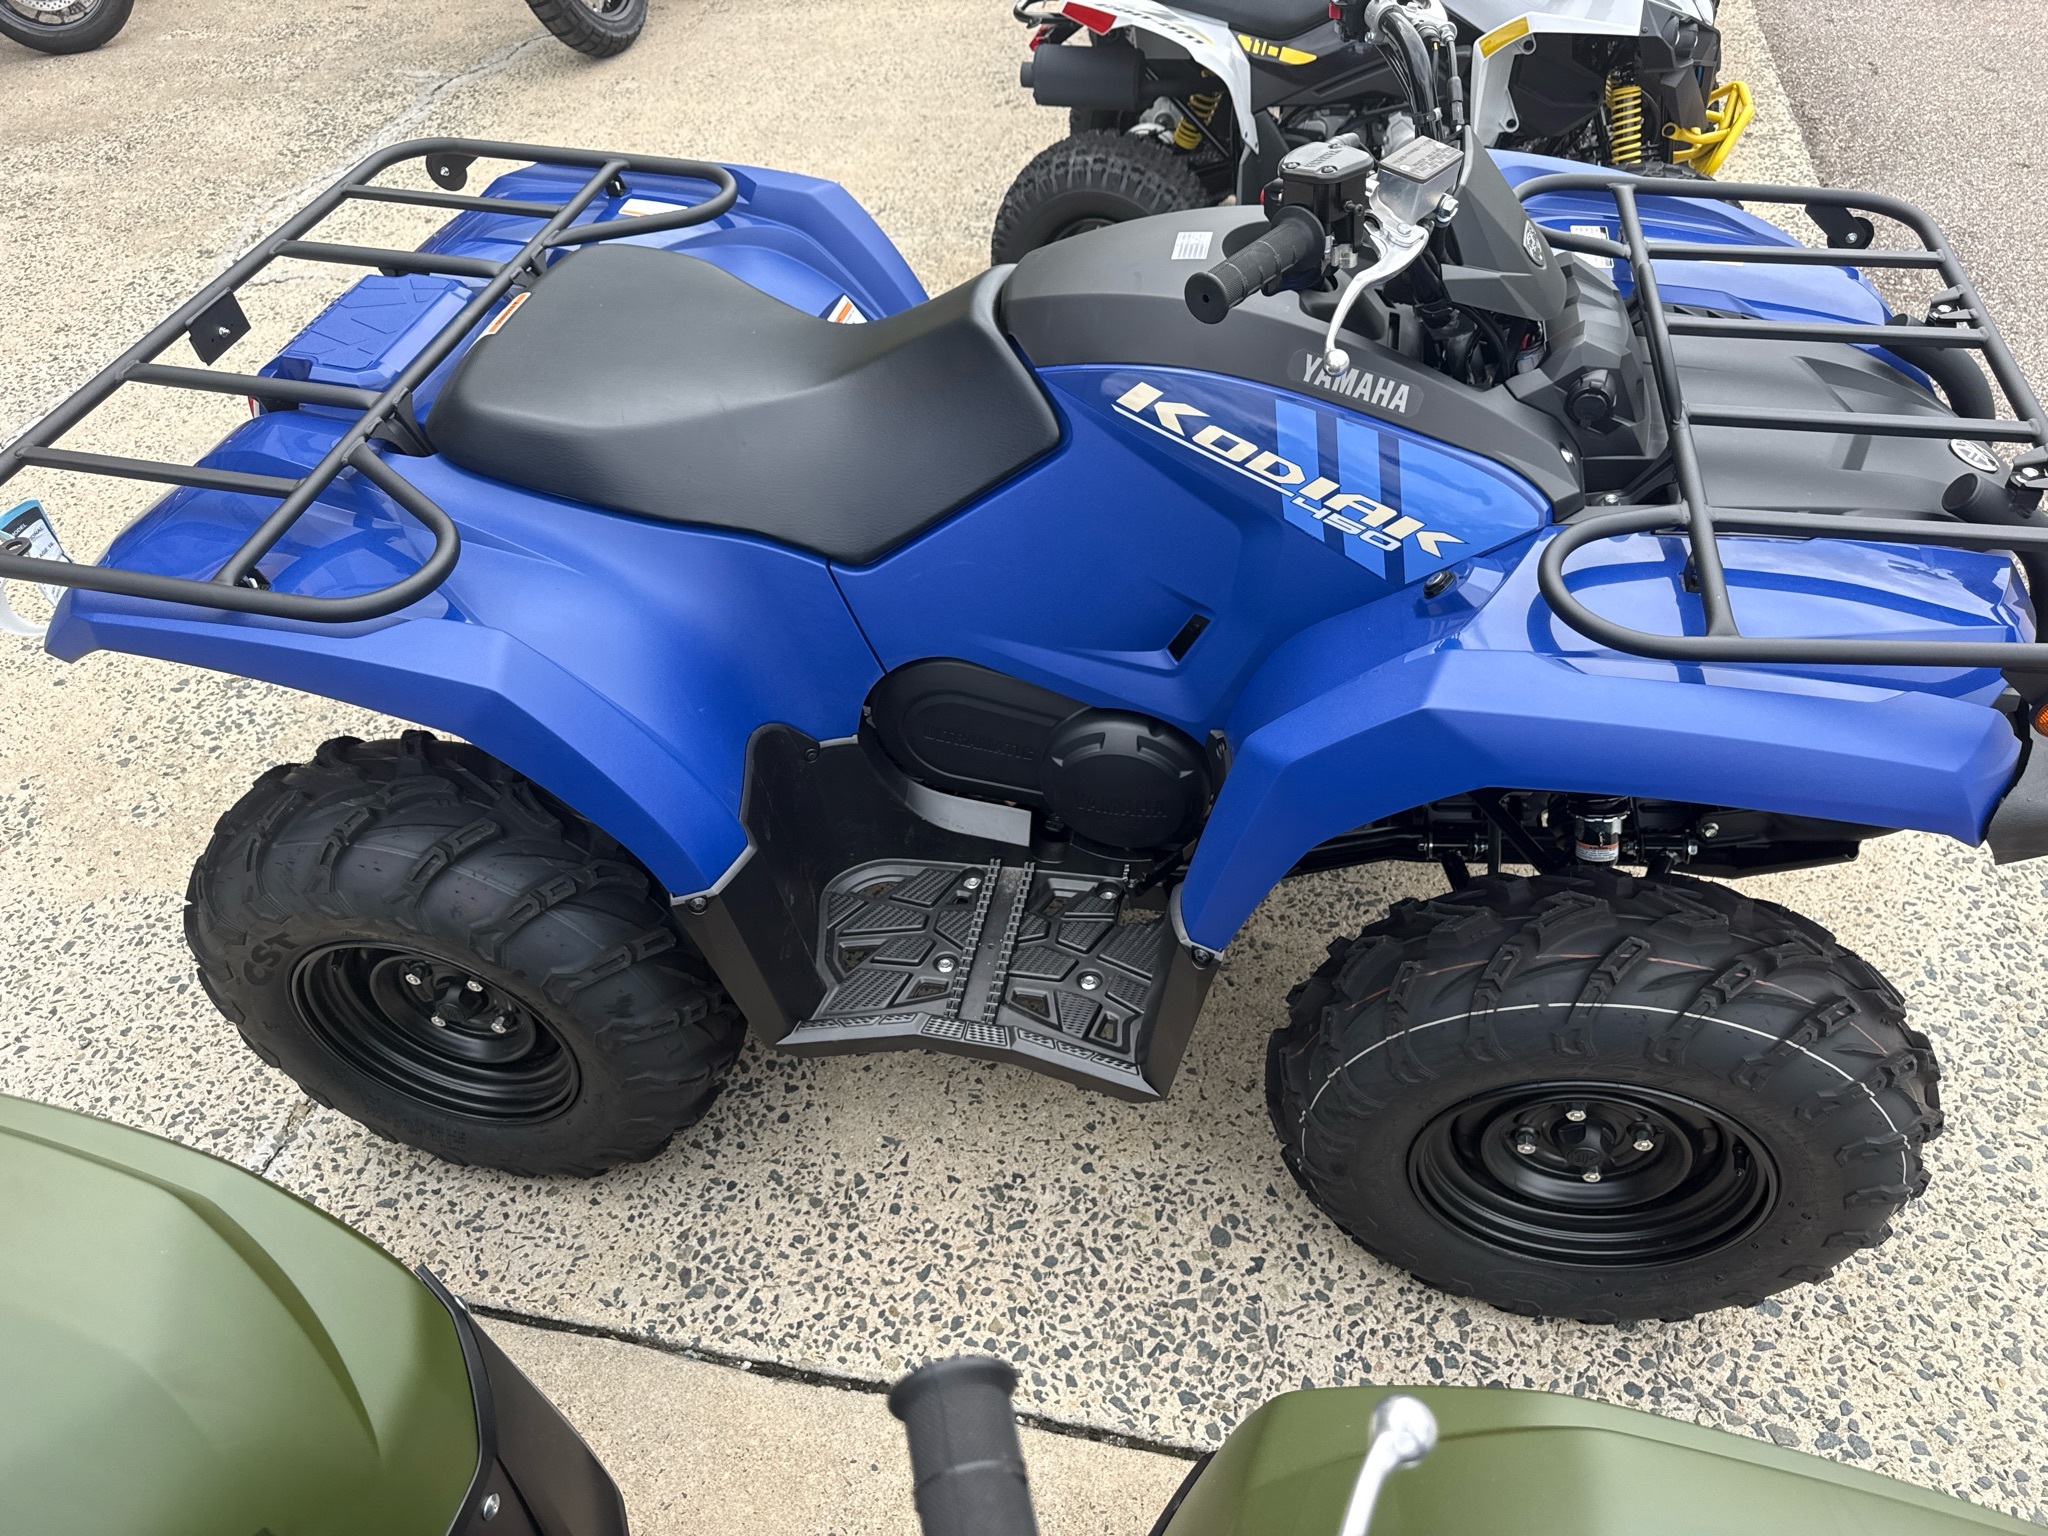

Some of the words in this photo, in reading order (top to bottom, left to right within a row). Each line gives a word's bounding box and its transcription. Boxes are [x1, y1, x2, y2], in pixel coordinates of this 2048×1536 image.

[1116, 382, 1469, 558] KODIAK
[1291, 496, 1402, 551] 450
[244, 931, 301, 986] CST
